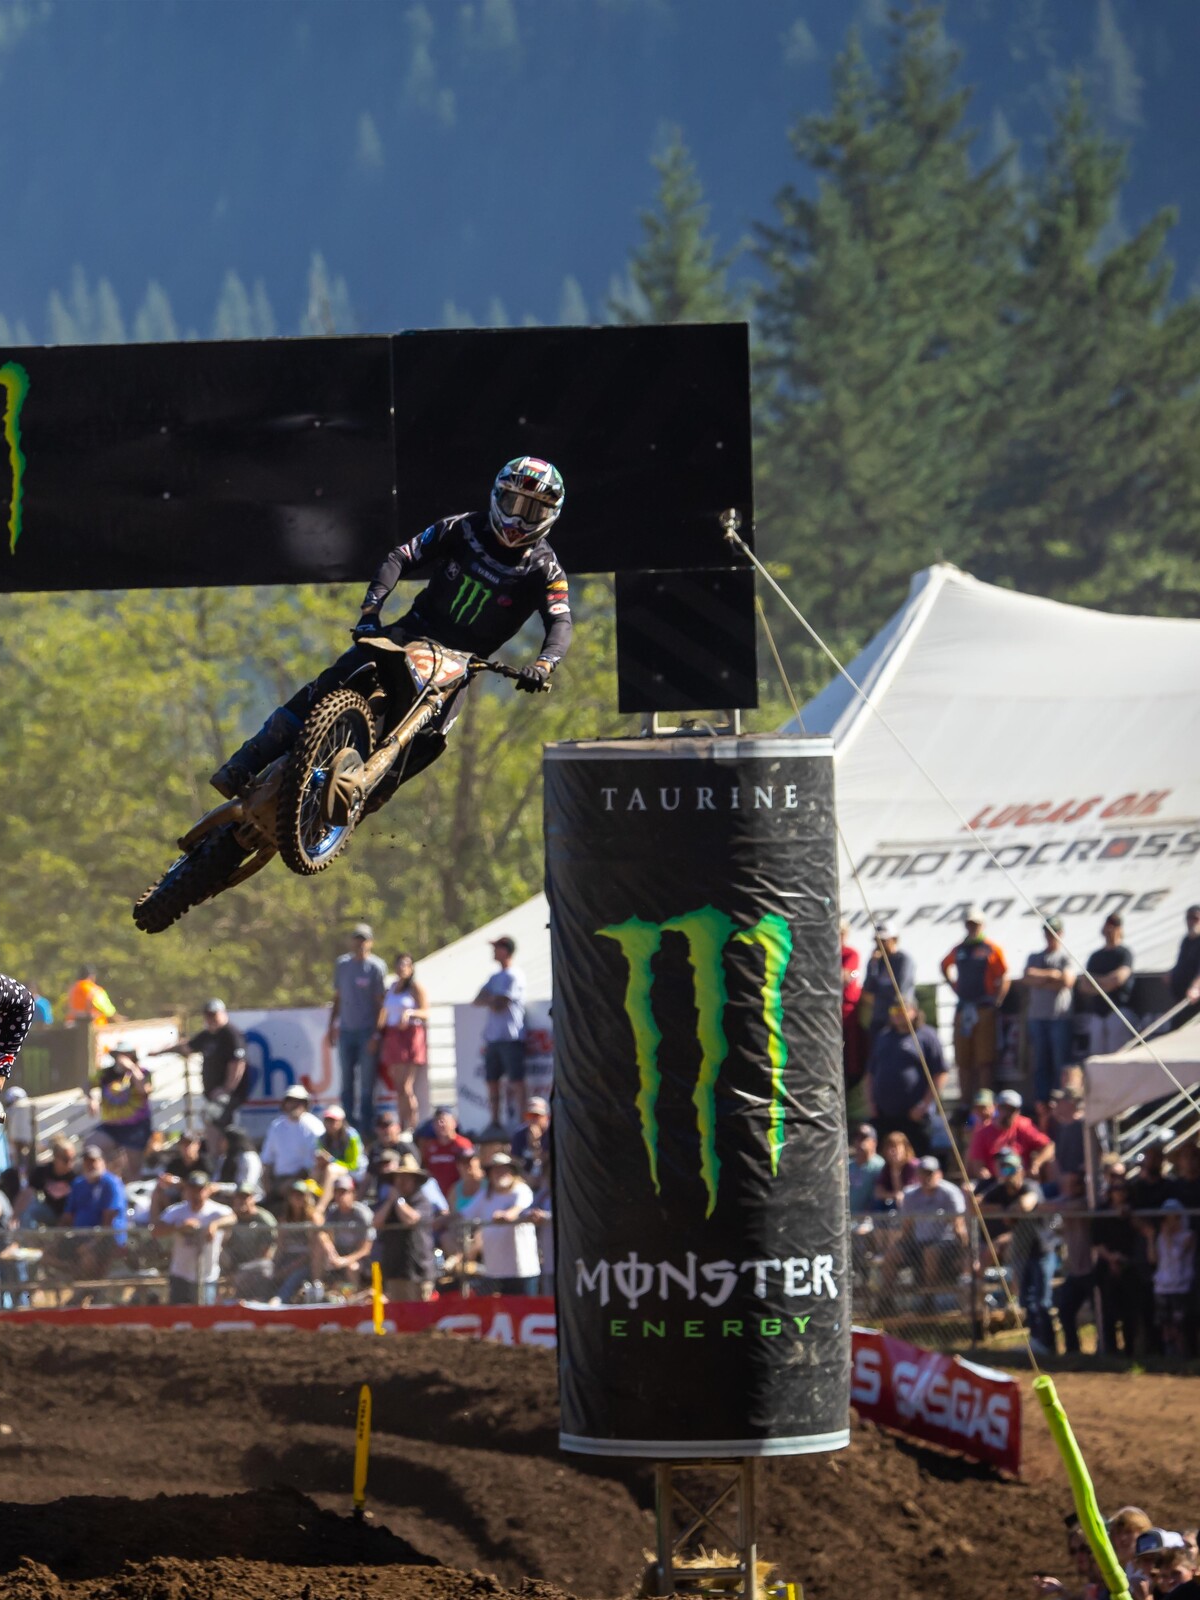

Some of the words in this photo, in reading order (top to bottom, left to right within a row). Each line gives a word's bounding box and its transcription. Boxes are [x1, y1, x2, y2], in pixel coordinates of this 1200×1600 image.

[601, 784, 799, 812] TAURINE
[960, 795, 1103, 832] LUCAS
[1099, 787, 1173, 819] OIL
[575, 1251, 838, 1310] MONSTER
[610, 1315, 811, 1338] ENERGY
